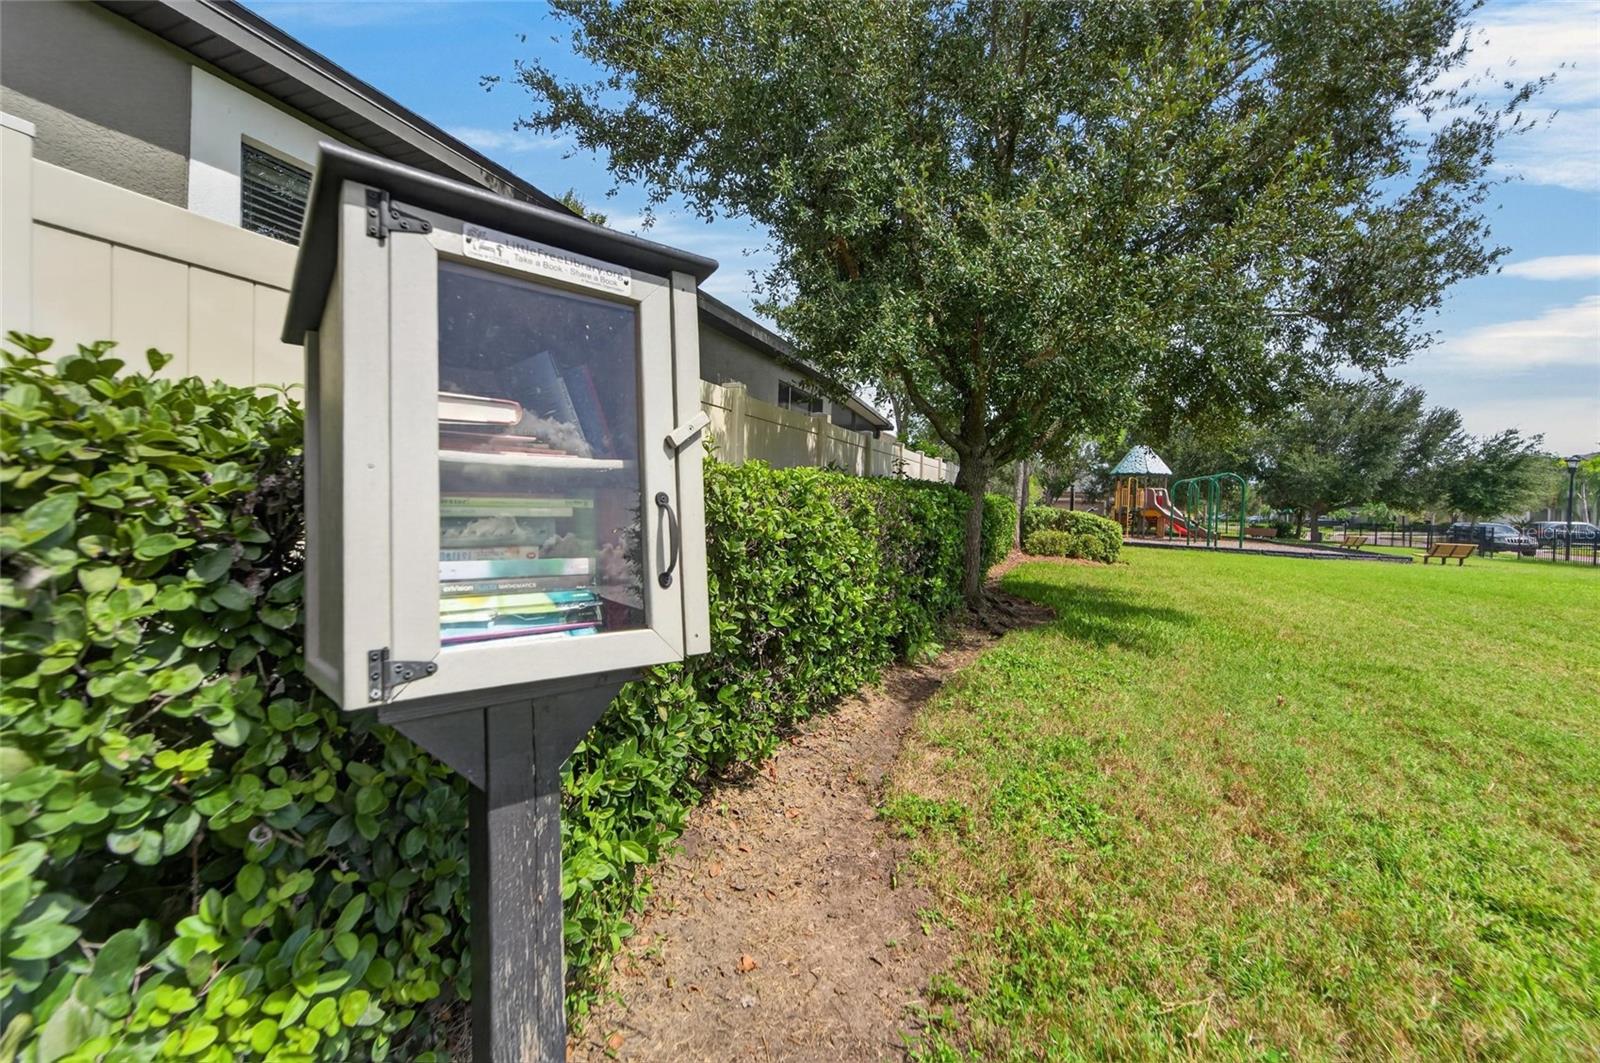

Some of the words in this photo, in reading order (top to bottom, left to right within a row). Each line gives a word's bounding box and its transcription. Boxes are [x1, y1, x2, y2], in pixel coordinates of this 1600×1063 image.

[514, 253, 533, 265] Take
[542, 261, 563, 273] Book
[570, 268, 592, 280] Share
[600, 276, 618, 286] Book
[498, 582, 537, 590] MATHEMATICS
